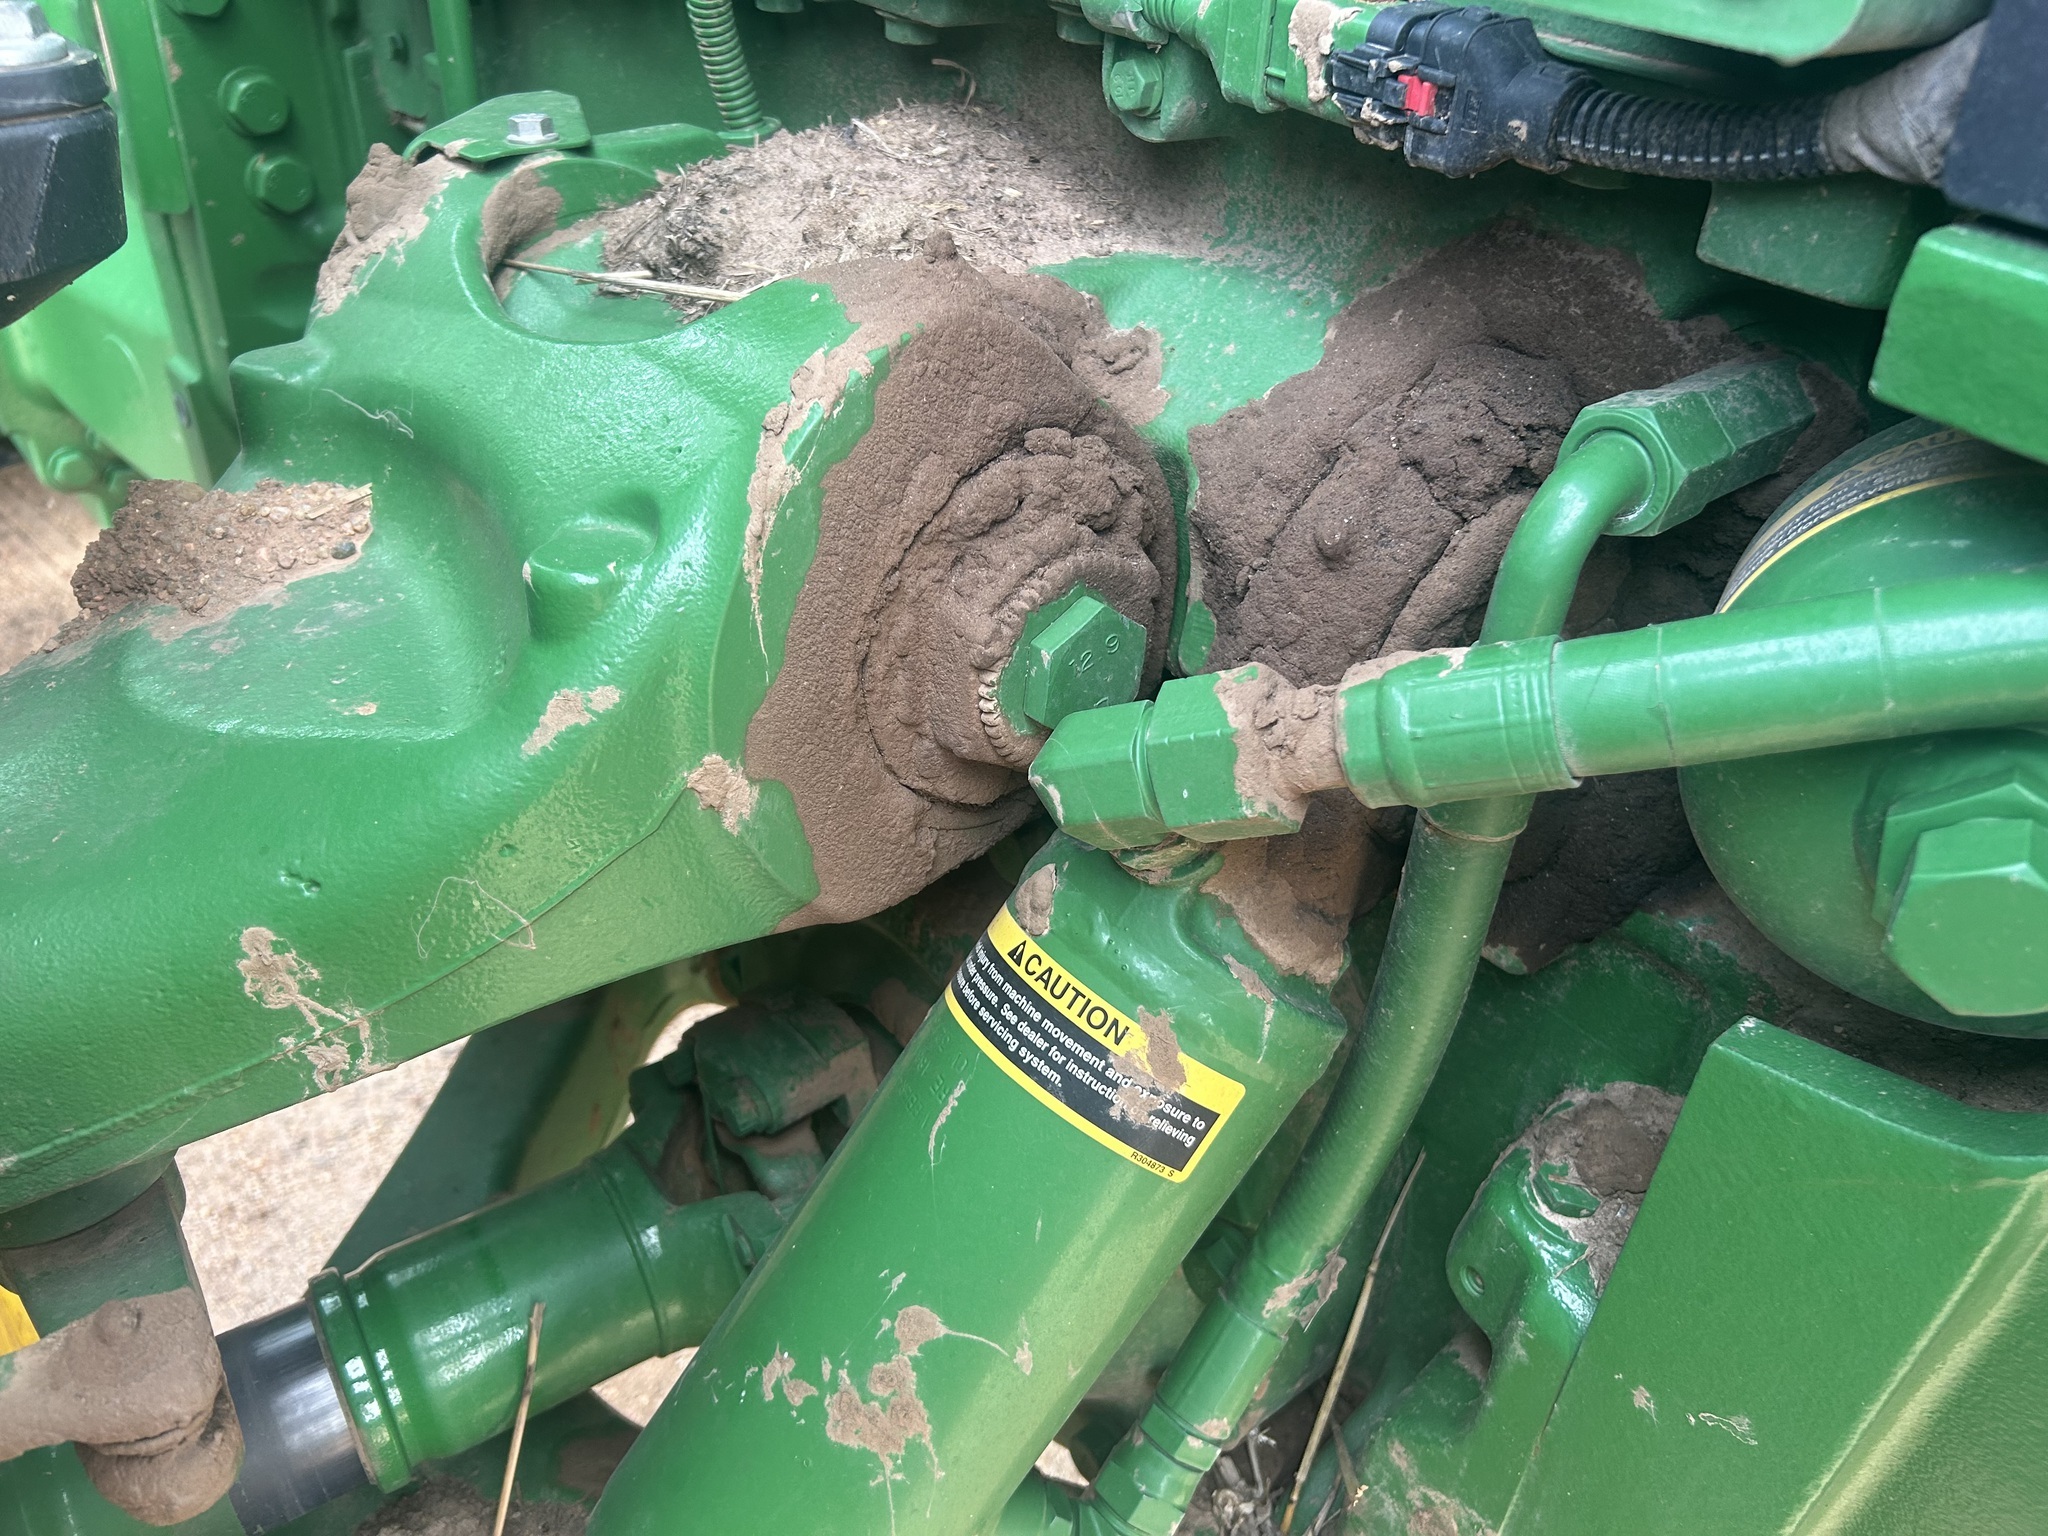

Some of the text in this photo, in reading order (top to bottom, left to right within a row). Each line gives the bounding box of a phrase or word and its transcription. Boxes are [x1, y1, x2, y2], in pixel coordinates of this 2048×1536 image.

[962, 982, 980, 1010] before
[978, 1006, 1020, 1052] servicing
[1018, 1046, 1062, 1088] system.
[987, 963, 1004, 986] from
[1002, 982, 1042, 1022] machine
[1041, 1018, 1106, 1072] movement
[1105, 1067, 1133, 1089] and
[1192, 1116, 1206, 1130] to
[1024, 953, 1130, 1046] CAUTION
[971, 973, 999, 1008] pressure.
[1001, 1003, 1018, 1025] See
[1017, 1021, 1049, 1051] dealer
[1048, 1046, 1067, 1064] for
[1148, 1115, 1196, 1148] relieving
[1130, 1151, 1175, 1178] R304873 S
